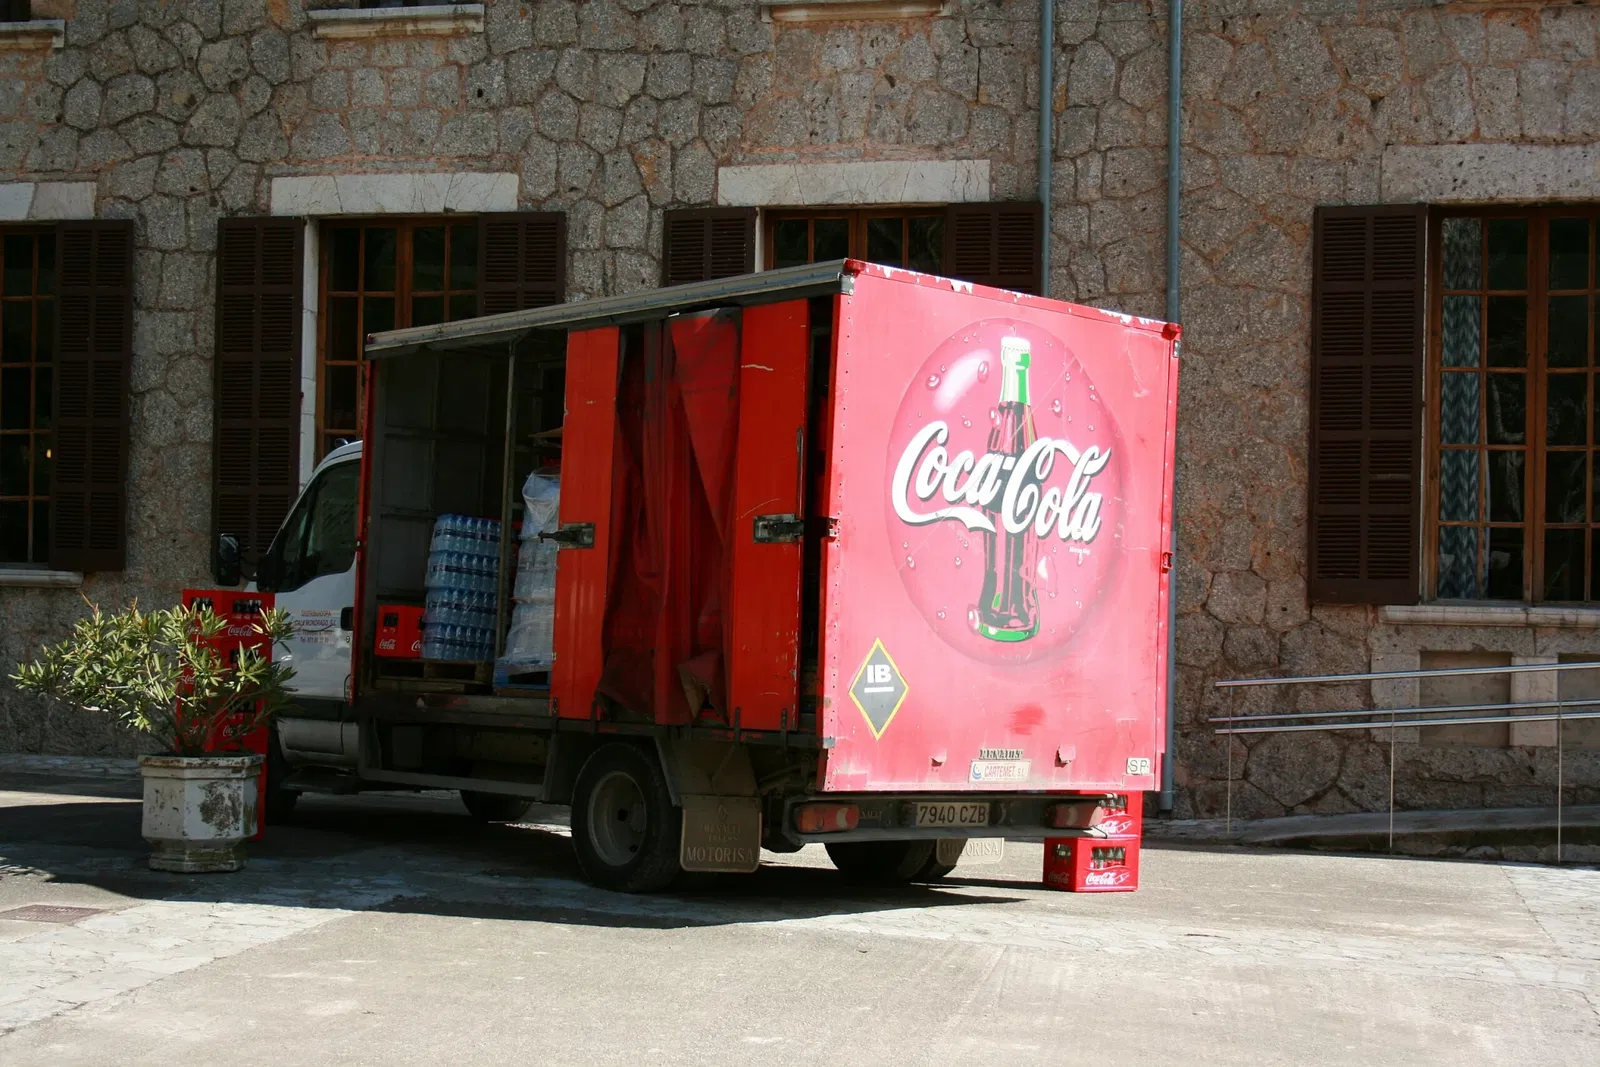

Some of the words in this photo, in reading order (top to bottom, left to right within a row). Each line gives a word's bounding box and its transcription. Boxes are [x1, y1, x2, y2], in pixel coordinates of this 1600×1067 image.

[891, 420, 1112, 542] Coca-Cola
[866, 664, 892, 683] IB
[920, 805, 955, 824] 7940
[960, 805, 986, 823] CZB
[686, 846, 754, 864] MOTORISA
